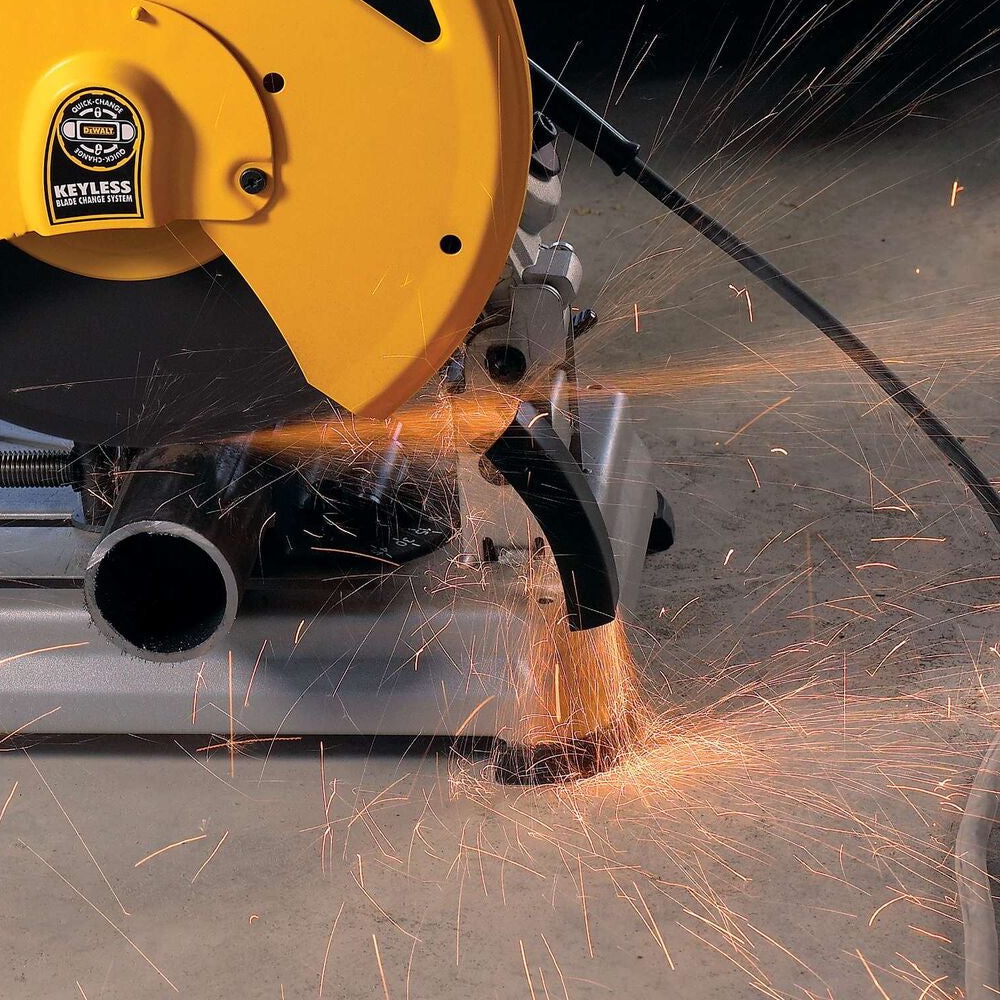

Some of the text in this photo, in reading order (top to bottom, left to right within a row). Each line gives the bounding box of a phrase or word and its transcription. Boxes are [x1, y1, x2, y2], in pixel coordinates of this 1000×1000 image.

[71, 98, 124, 114] QUICK-CHANGE
[53, 180, 132, 198] KEYLESS
[56, 194, 133, 207] BLADE CHANGE SYSTEM
